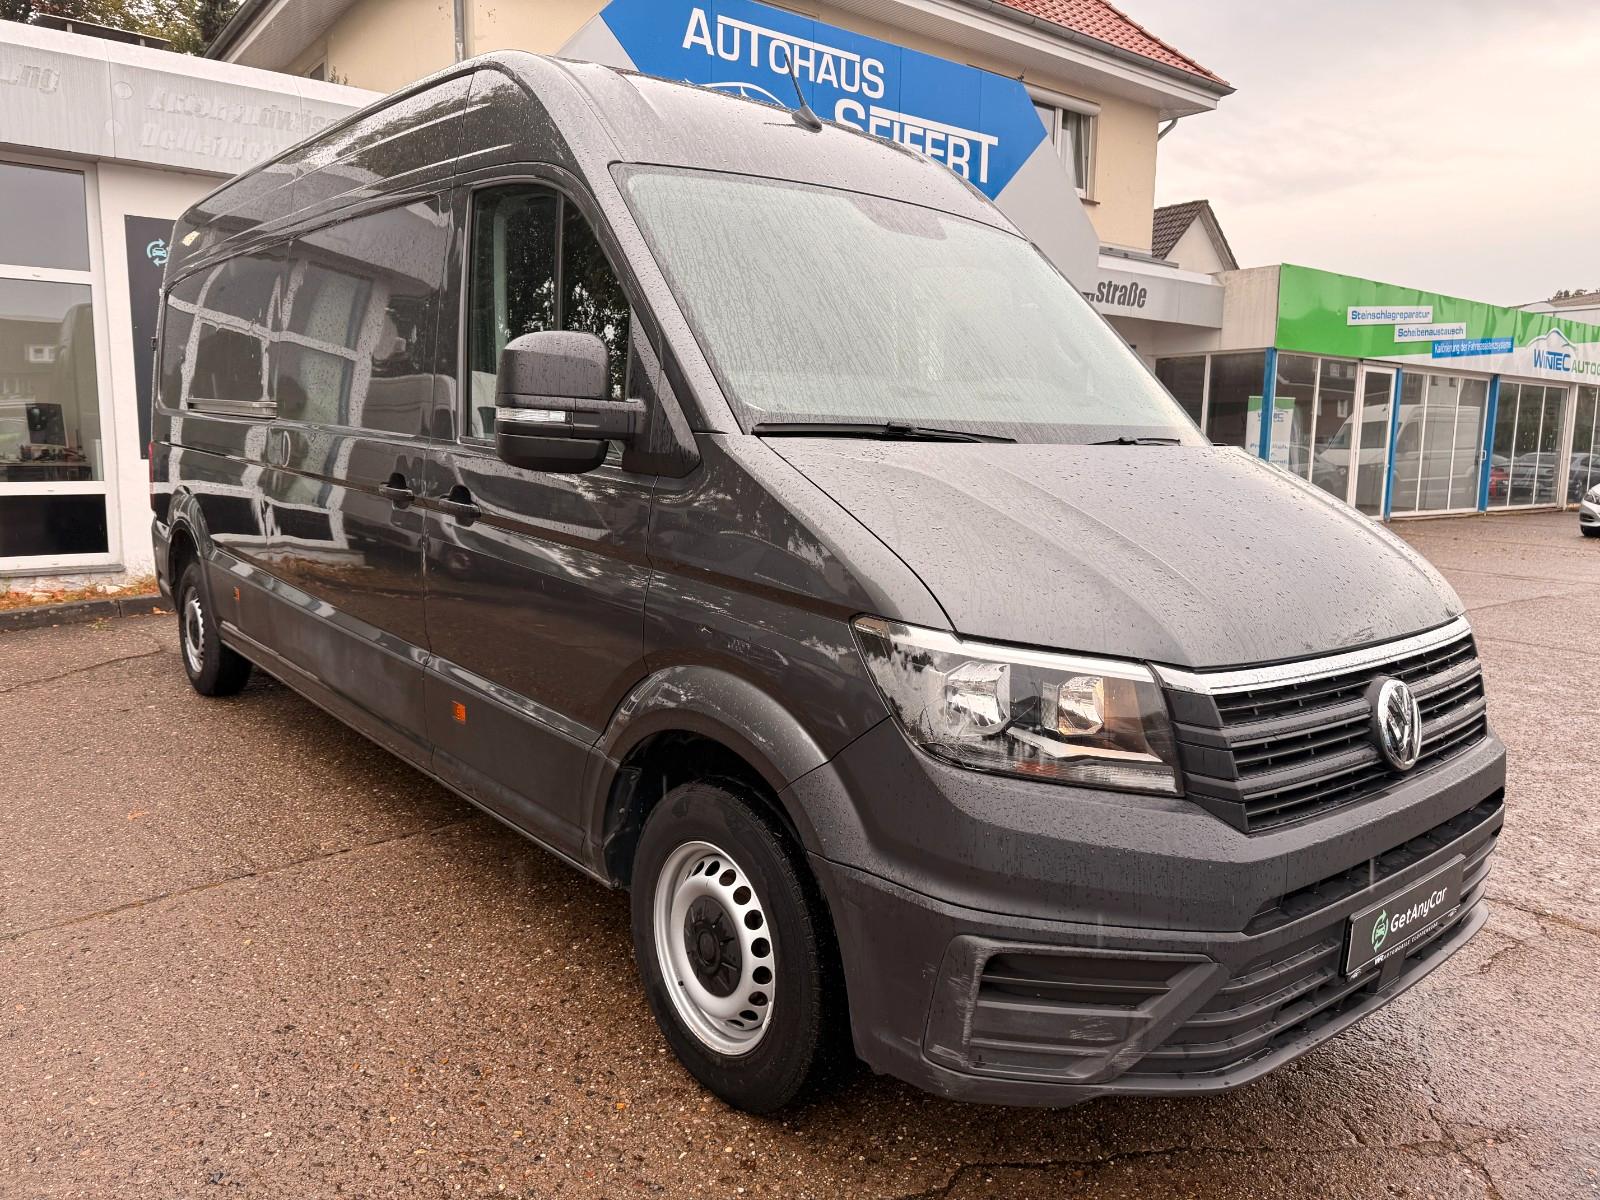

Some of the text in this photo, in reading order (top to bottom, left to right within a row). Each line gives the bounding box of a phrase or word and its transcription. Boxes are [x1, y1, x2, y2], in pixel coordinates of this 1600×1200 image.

[682, 7, 885, 99] AUTOHAUS
[834, 98, 999, 184] SEIFERT
[1351, 310, 1430, 321] Steinschlagreparatur
[1397, 326, 1464, 337] Scheibenaustausch
[1390, 886, 1448, 933] GetAnyCar
